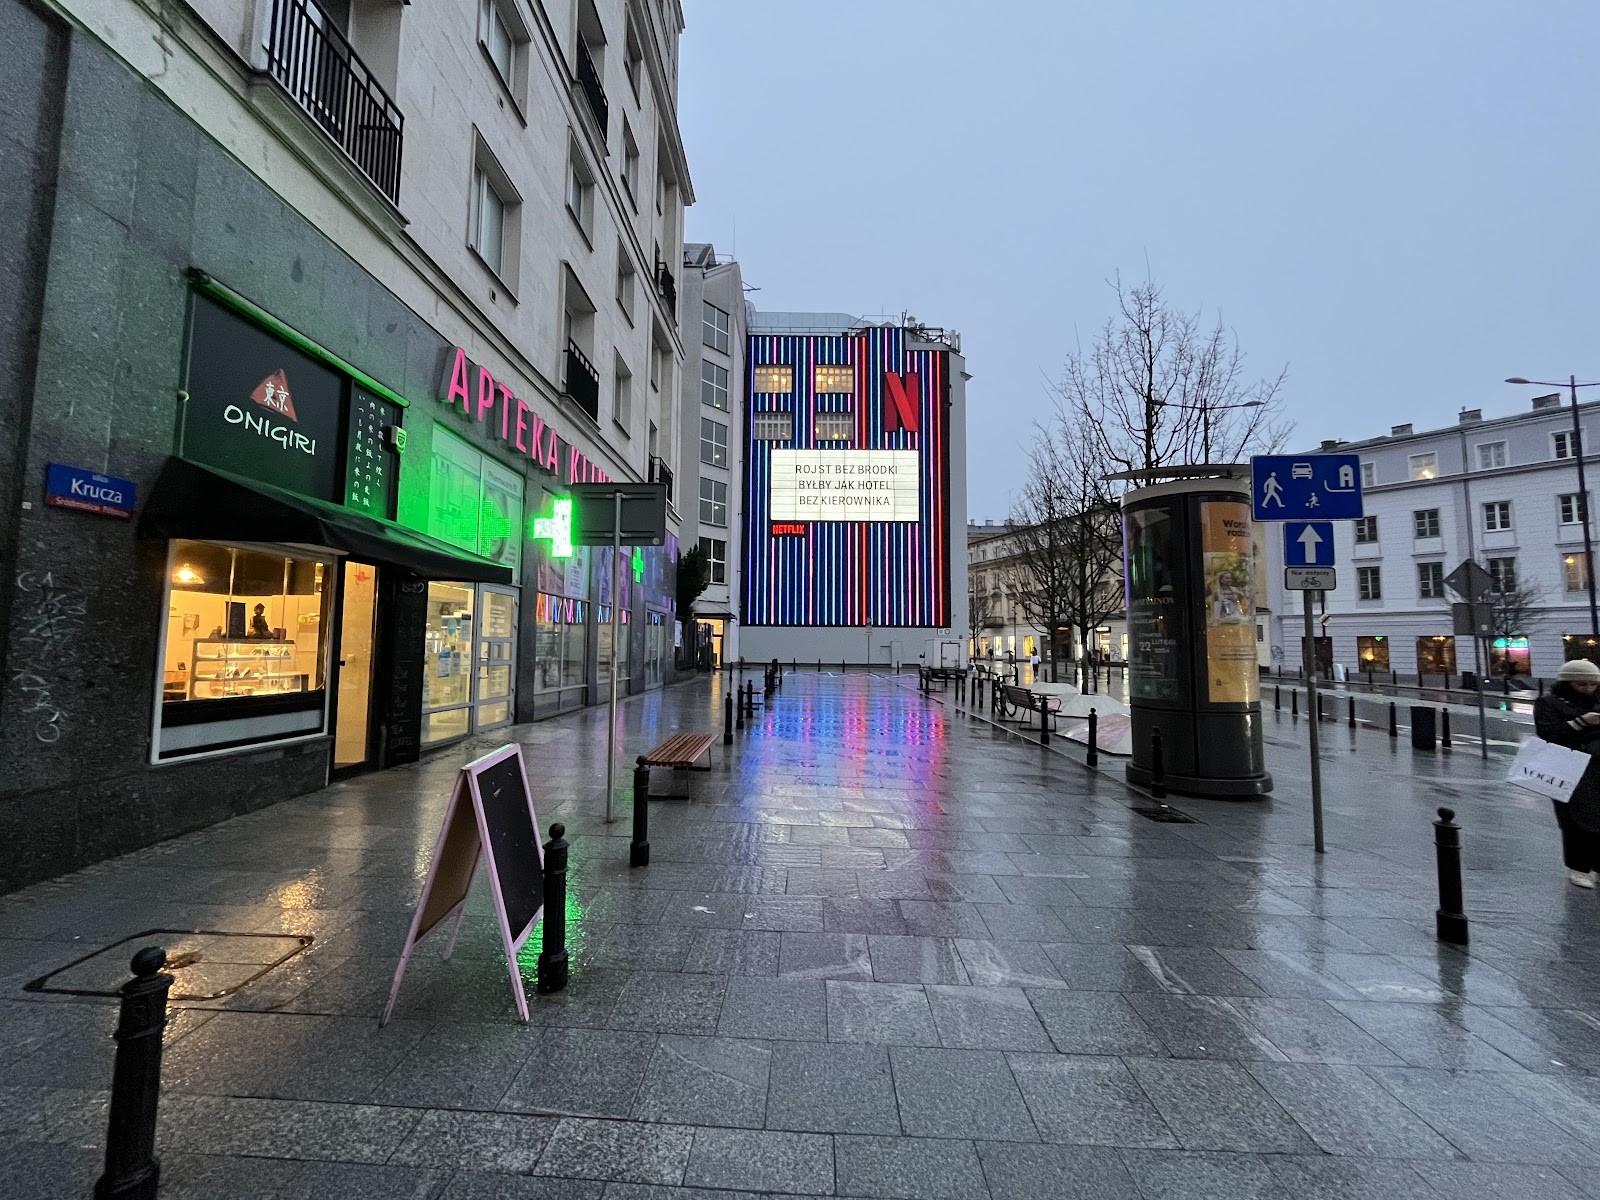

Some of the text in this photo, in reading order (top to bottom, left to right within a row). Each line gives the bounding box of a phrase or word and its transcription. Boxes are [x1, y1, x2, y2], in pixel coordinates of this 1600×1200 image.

[884, 372, 918, 432] N
[448, 346, 559, 476] APTEKA
[223, 404, 316, 456] ONIGIRI
[795, 464, 898, 475] ROJST BEZ BRODKI
[71, 477, 122, 504] Krucza
[798, 480, 892, 490] BYŁBY JAK HOTEL
[799, 495, 890, 506] BEZ KIEROWNIKA
[772, 524, 805, 535] NETFLIX
[1139, 641, 1151, 651] 22
